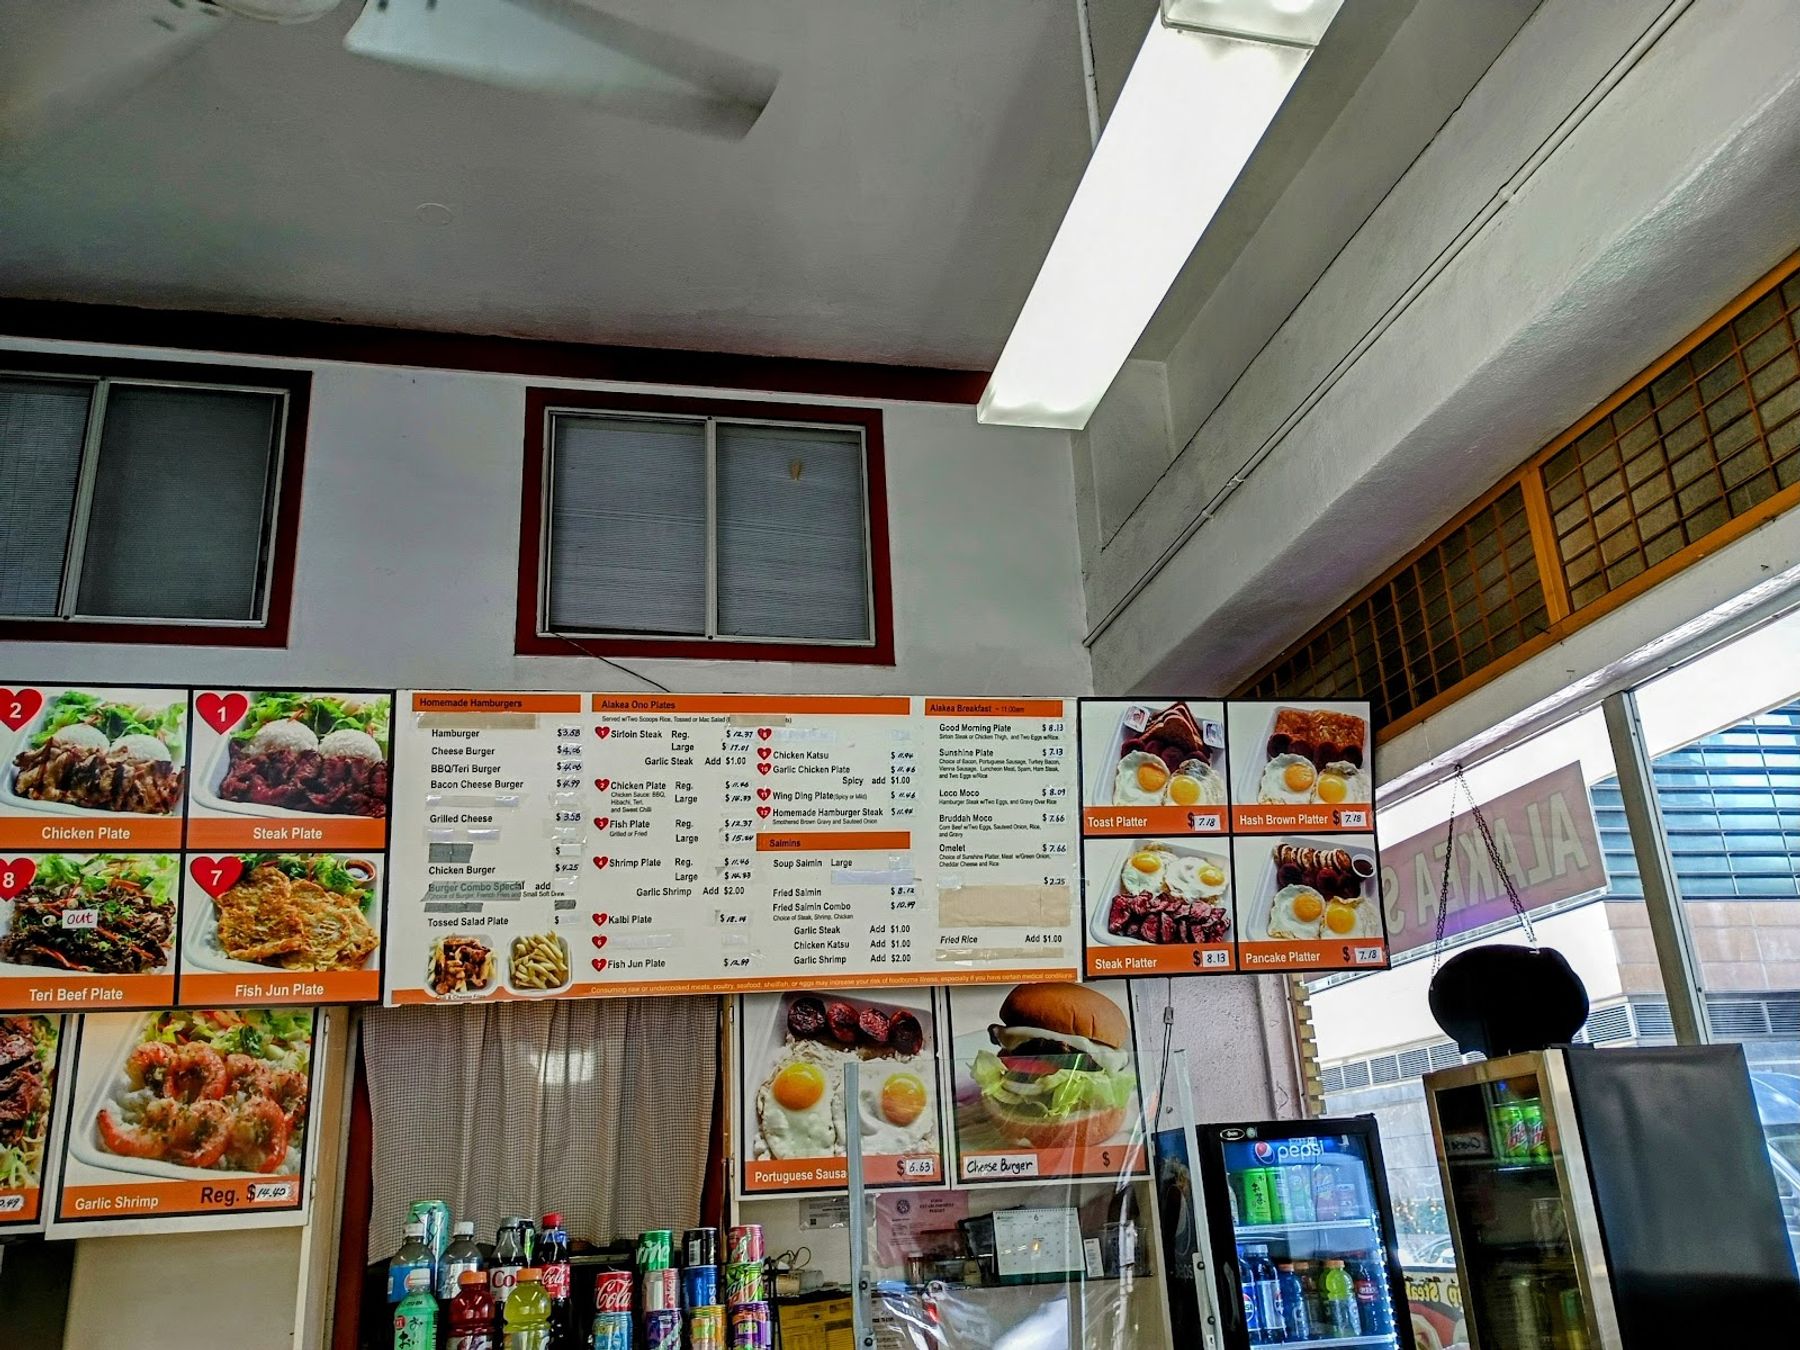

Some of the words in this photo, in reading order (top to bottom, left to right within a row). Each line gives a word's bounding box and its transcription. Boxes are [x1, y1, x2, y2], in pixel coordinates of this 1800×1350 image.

[420, 698, 468, 707] Homemade
[470, 698, 522, 709] Hamburgers
[601, 701, 629, 709] Alakea
[631, 701, 648, 709] Ono
[650, 701, 675, 709] Plates
[930, 704, 955, 712] Alakea
[957, 704, 992, 712] Breakfast
[10, 702, 22, 719] 2
[217, 706, 226, 723] 1
[431, 729, 480, 739] Hamburger
[939, 724, 960, 732] Good
[961, 724, 991, 734] Morning
[993, 724, 1012, 732] Plate
[611, 730, 637, 739] Sirloin
[639, 730, 663, 738] Steak
[671, 730, 690, 740] Reg.
[431, 747, 464, 756] Cheese
[466, 747, 495, 757] Burger
[671, 743, 694, 752] Large
[773, 751, 805, 760] Chicken
[806, 751, 829, 759] Katsu
[939, 749, 974, 757] Sunshine
[975, 749, 994, 757] Plate
[645, 757, 669, 766] Garlic
[671, 757, 694, 765] Steak
[705, 757, 721, 765] Add
[725, 757, 746, 765] $1.00
[431, 764, 469, 773] BBQ/Teri
[472, 765, 501, 775] Burger
[773, 766, 796, 774] Garlic
[798, 765, 829, 774] Chicken
[831, 765, 850, 773] Plate
[430, 780, 458, 789] Bacon
[460, 780, 492, 789] Cheese
[495, 780, 524, 790] Burger
[610, 781, 643, 790] Chicken
[645, 781, 667, 790] Plate
[675, 781, 693, 791] Reg.
[842, 777, 864, 786] Spicy
[891, 776, 911, 784] $1.00
[773, 792, 793, 801] Wing
[794, 792, 813, 801] Ding
[939, 789, 958, 797] Loco
[960, 789, 980, 797] Moco
[675, 795, 698, 804] Large
[772, 808, 816, 817] Homemade
[818, 807, 860, 817] Hamburger
[862, 808, 883, 816] Steak
[430, 814, 458, 823] Grilled
[461, 814, 493, 823] Cheese
[939, 814, 971, 823] Bruddah
[1088, 817, 1113, 828] Toast
[1116, 816, 1148, 828] Platter
[1239, 814, 1263, 826] Hash
[1265, 814, 1295, 826] Brown
[1297, 813, 1328, 825] Platter
[609, 820, 628, 828] Fish
[630, 820, 650, 828] Plate
[675, 819, 694, 829] Reg.
[41, 826, 95, 840] Chicken
[98, 827, 131, 840] Plate
[253, 826, 289, 840] Steak
[291, 826, 323, 840] Plate
[676, 834, 699, 844] Large
[939, 844, 966, 852] Omelet
[609, 859, 639, 868] Shrimp
[641, 858, 661, 867] Plate
[675, 858, 693, 868] Reg.
[773, 860, 794, 869] Soup
[831, 859, 853, 868] Large
[428, 866, 464, 875] Chicken
[466, 866, 496, 876] Burger
[2, 871, 15, 888] 8
[210, 869, 223, 886] 7
[675, 872, 698, 882] Large
[636, 888, 660, 897] Garlic
[662, 887, 692, 897] Shrimp
[702, 887, 719, 895] Add
[723, 886, 745, 895] $2.00
[773, 889, 793, 897] Fried
[773, 903, 793, 912] Fried
[823, 902, 851, 910] Combo
[428, 918, 459, 927] Tossed
[461, 917, 485, 926] Salad
[487, 916, 509, 925] Plate
[608, 915, 629, 924] Kalbi
[631, 915, 652, 923] Plate
[794, 926, 817, 935] Garlic
[819, 926, 840, 934] Steak
[869, 925, 886, 933] Add
[890, 924, 910, 933] $1.00
[794, 941, 825, 950] Chicken
[827, 940, 850, 949] Katsu
[870, 940, 886, 948] Add
[891, 939, 911, 948] $1.00
[940, 935, 960, 944] Fried
[961, 935, 978, 943] Rice
[1025, 935, 1040, 943] Add
[1043, 935, 1062, 943] $1.00
[794, 956, 817, 965] Garlic
[819, 955, 847, 965] Shrimp
[870, 954, 886, 962] Add
[891, 954, 911, 962] $2.00
[1245, 952, 1287, 963] Pancake
[1289, 951, 1320, 963] Platter
[608, 960, 626, 969] Fish
[627, 960, 643, 968] Jun
[645, 959, 666, 968] Plate
[1095, 958, 1122, 969] Steak
[1125, 957, 1157, 969] Platter
[29, 989, 54, 1002] Teri
[57, 988, 87, 1003] Beef
[90, 987, 123, 1001] Plate
[235, 984, 262, 998] Fish
[265, 984, 290, 997] Jun
[292, 983, 324, 997] Plate
[1277, 1140, 1325, 1160] pepsi
[1001, 1159, 1033, 1175] Burger
[755, 1170, 813, 1183] Portuguese
[816, 1168, 846, 1181] Sausa
[75, 1198, 111, 1211] Garlic
[115, 1196, 158, 1210] Shrimp
[201, 1187, 240, 1206] Reg.
[492, 1270, 516, 1289] Co
